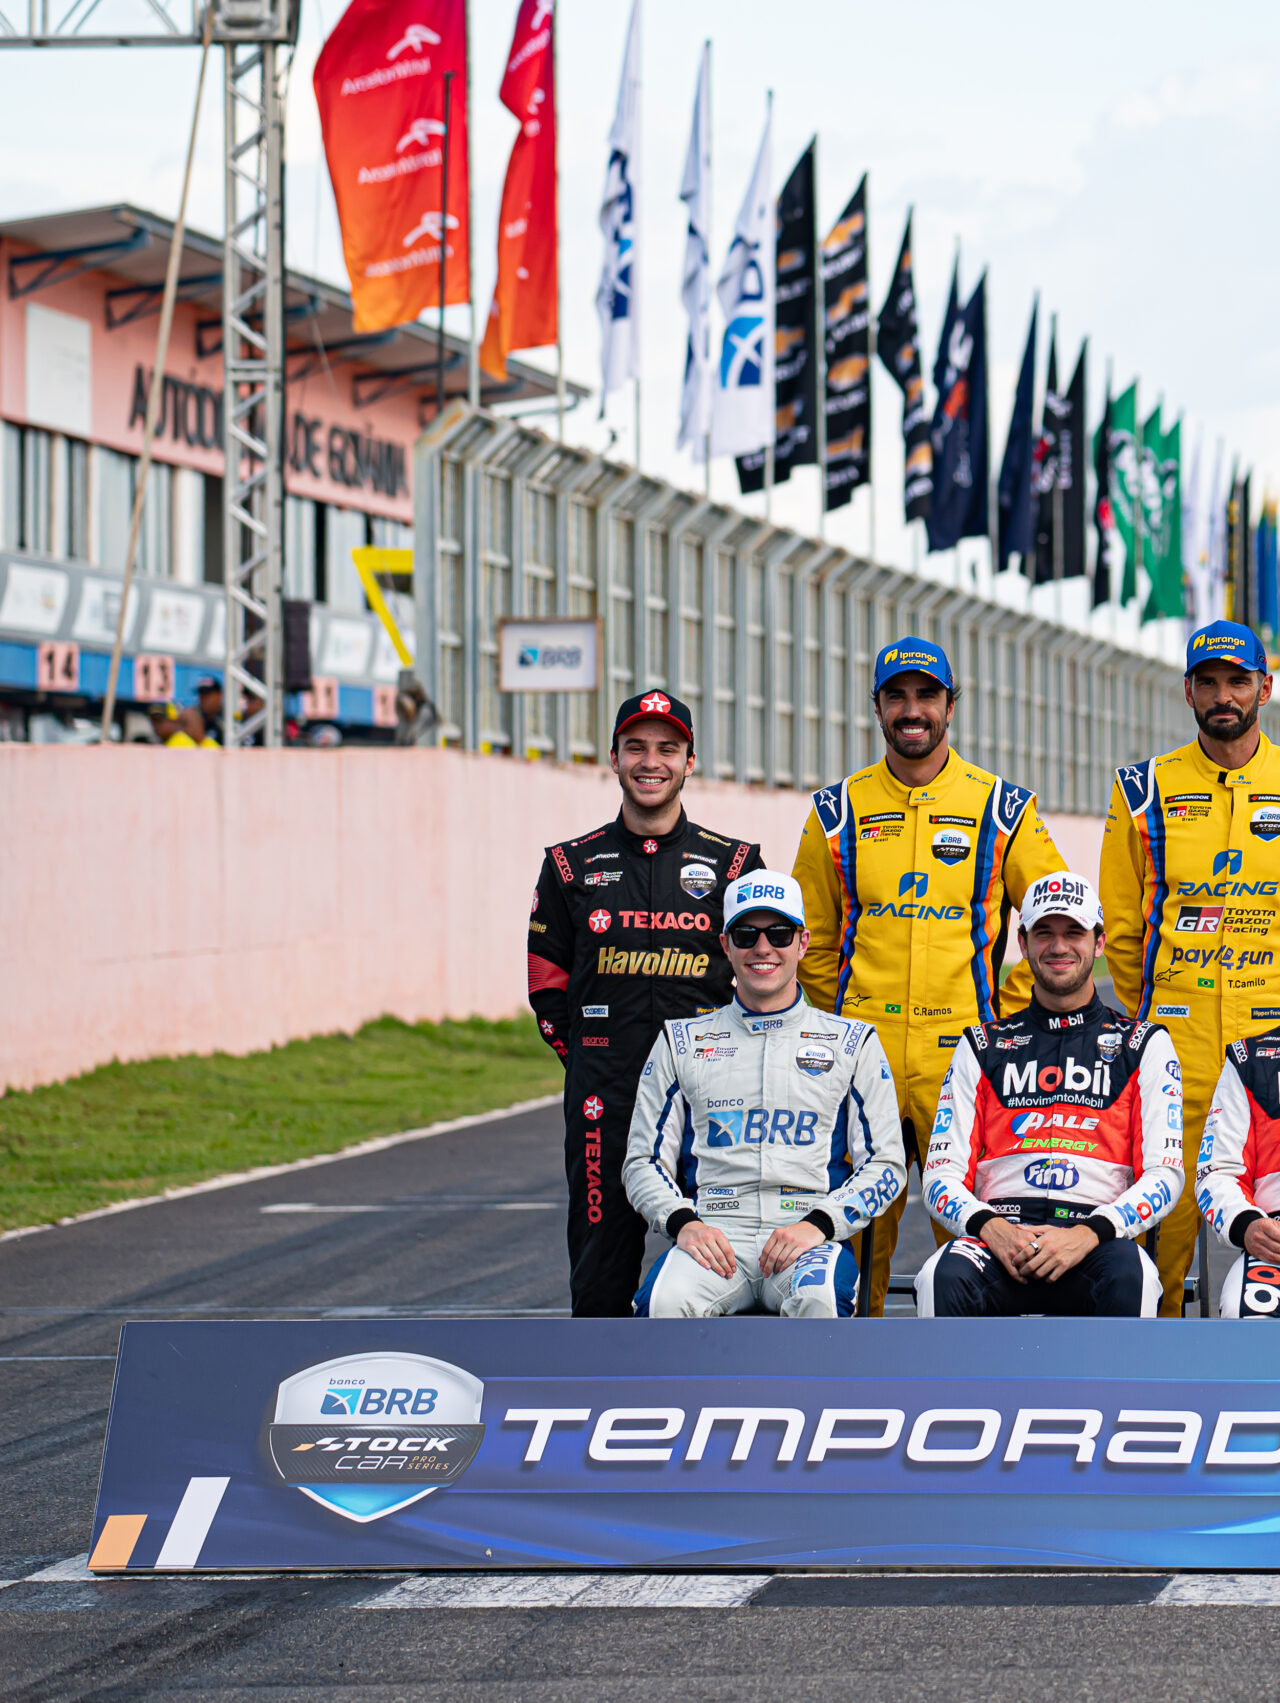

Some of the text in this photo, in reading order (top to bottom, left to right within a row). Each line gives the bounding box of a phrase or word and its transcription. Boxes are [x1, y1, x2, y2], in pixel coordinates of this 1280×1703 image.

[1206, 635, 1245, 646] Ipiranga
[899, 651, 937, 663] Ipiranga
[42, 649, 76, 684] 14
[140, 661, 170, 695] 13
[1167, 808, 1187, 818] GR
[860, 830, 880, 840] GR
[947, 836, 961, 844] BRB
[551, 846, 575, 883] sparco
[726, 843, 750, 881] sparco
[752, 885, 785, 900] BRB
[1033, 878, 1085, 898] Mobil
[1176, 881, 1279, 897] RACING
[1032, 894, 1084, 908] HYBRID
[866, 903, 965, 920] RACING
[1225, 907, 1276, 917] TOYOTA
[619, 911, 710, 931] TEXACO
[1176, 916, 1221, 932] GR
[1223, 917, 1271, 925] GAZOO
[1222, 925, 1269, 936] Racing
[597, 947, 709, 977] Havoline
[1227, 978, 1266, 989] T.Camilo
[913, 1006, 952, 1016] C.Ramos
[762, 1019, 783, 1031] BRB
[1048, 1014, 1084, 1030] Mobil
[582, 1036, 609, 1047] sparco
[671, 1022, 687, 1055] sparco
[1002, 1057, 1111, 1097] Mobil
[707, 1098, 744, 1109] banco
[1007, 1094, 1104, 1109] #MovimentoMobil
[743, 1109, 819, 1147] BRB
[928, 1141, 951, 1153] EKT
[1020, 1137, 1098, 1152] ENERGY
[585, 1127, 603, 1224] TEXACO
[1026, 1162, 1075, 1188] Fini
[857, 1168, 900, 1218] BRB
[706, 1200, 740, 1211] sparco
[1114, 1180, 1171, 1228] Mobil
[328, 1377, 366, 1386] banco
[359, 1387, 438, 1415] BRB
[315, 1436, 457, 1453] STOCK
[408, 1462, 450, 1471] SERIES
[411, 1455, 436, 1463] PRO
